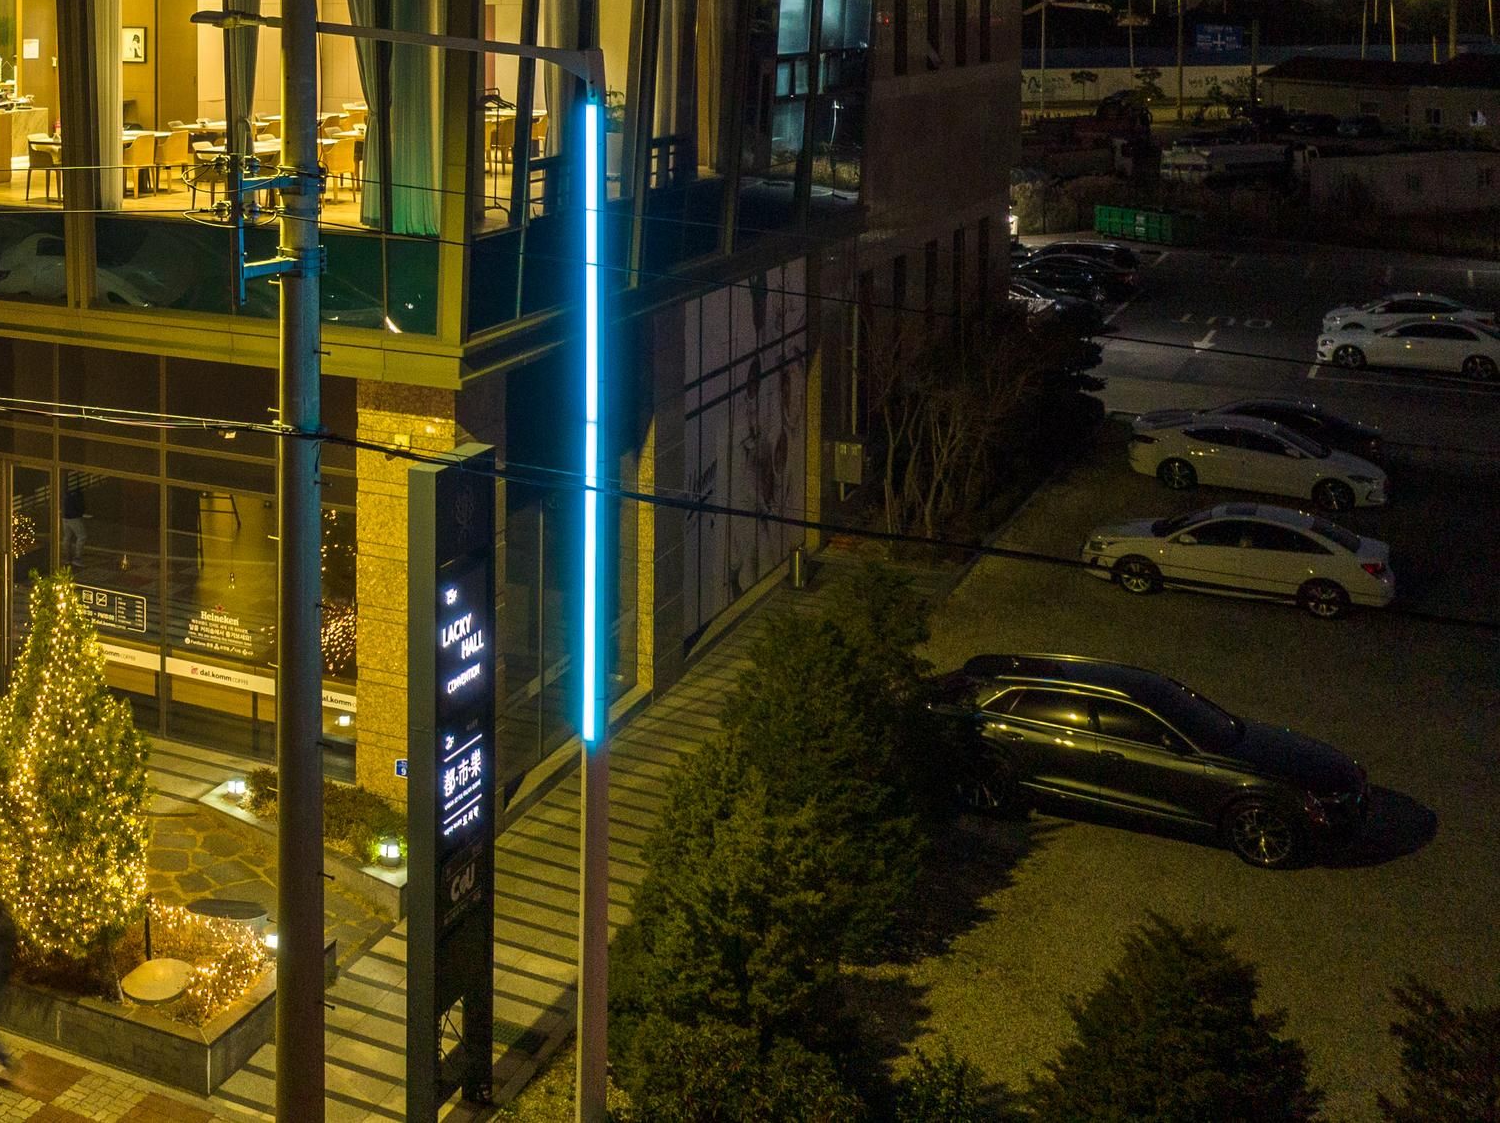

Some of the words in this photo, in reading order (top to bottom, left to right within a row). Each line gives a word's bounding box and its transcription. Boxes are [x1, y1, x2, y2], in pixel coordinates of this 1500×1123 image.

[200, 610, 240, 626] Heineken
[442, 612, 472, 648] LACKY
[461, 629, 484, 660] HALL
[200, 669, 232, 682] dal.komm
[447, 662, 481, 694] CONVENTION
[322, 694, 352, 708] al.komm
